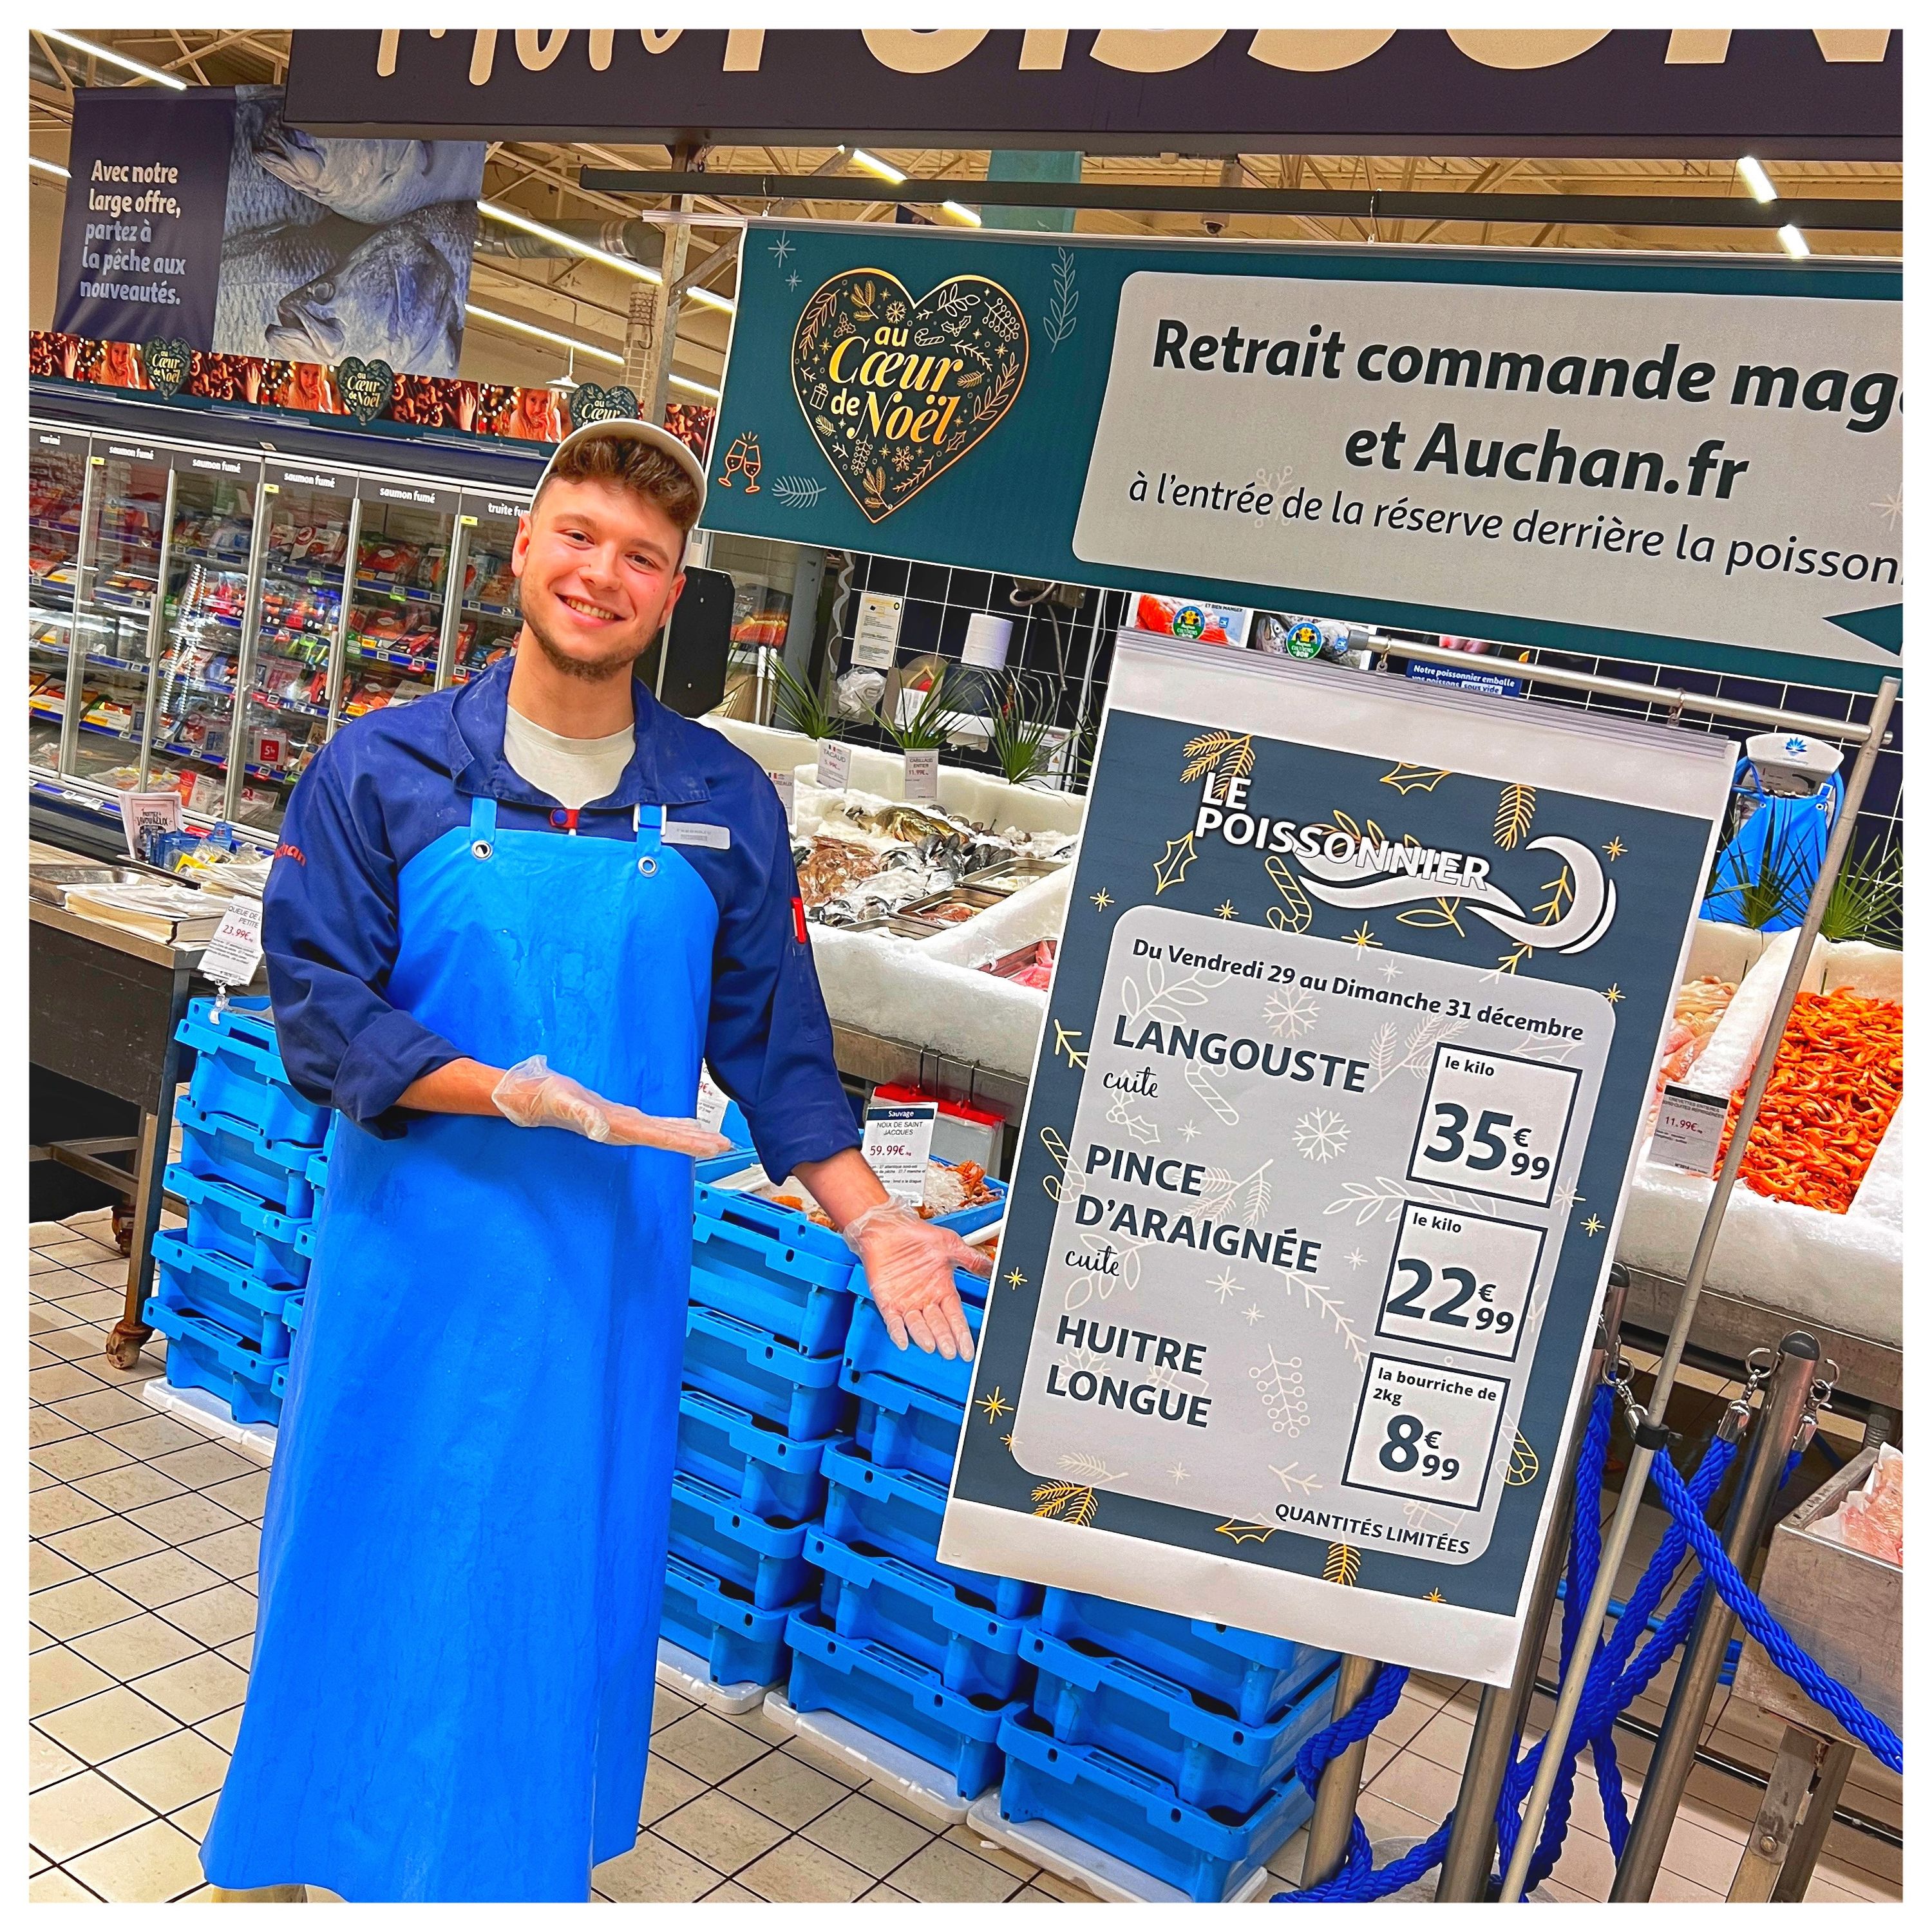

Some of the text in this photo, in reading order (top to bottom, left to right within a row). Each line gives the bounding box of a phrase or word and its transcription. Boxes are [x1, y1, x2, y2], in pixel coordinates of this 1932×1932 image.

[91, 160, 178, 184] Avec notre
[89, 188, 181, 218] large offre,
[84, 218, 151, 245] partez à
[82, 246, 186, 276] la pêche aux
[80, 281, 180, 305] nouveautés.
[874, 326, 909, 347] au
[829, 336, 964, 392] Cœur
[1153, 319, 1903, 433] Retrait commande mag
[831, 388, 961, 446] de Noël
[109, 446, 155, 460] saumon fumé
[192, 457, 242, 473] saumon fumé
[1345, 422, 1750, 500] et Auchan.fr
[284, 472, 335, 489] saumon fumé
[379, 487, 435, 504] saumon fumé
[488, 502, 514, 516] truite
[1130, 471, 1903, 585] à l'entrée de la réserve derrière la poisson
[1414, 665, 1515, 688] Notre poissonnier emballe
[1482, 685, 1499, 694] vide
[1201, 772, 1252, 810] LE
[1195, 808, 1490, 891] POISSONNIER
[228, 905, 249, 918] QUEUE
[238, 917, 259, 928] PETITE
[1133, 938, 1584, 1041] Du Vendredi 29 au Dimanche 31 décembre
[1113, 1015, 1370, 1093] LANGOUSTE
[1446, 1056, 1495, 1076] le kilo
[1103, 1066, 1159, 1098] cuite
[1084, 1144, 1206, 1197] PINCE
[1075, 1195, 1322, 1274] D'ARAIGNÉE
[1413, 1212, 1461, 1233] le kilo
[1065, 1245, 1120, 1276] cuite
[1056, 1314, 1207, 1376] HUITRE
[1046, 1365, 1212, 1428] LONGUE
[1372, 1388, 1403, 1406] 2kg
[1378, 1367, 1497, 1401] la bourriche de
[1275, 1504, 1470, 1554] QUANTITÉS LIMITÉES
